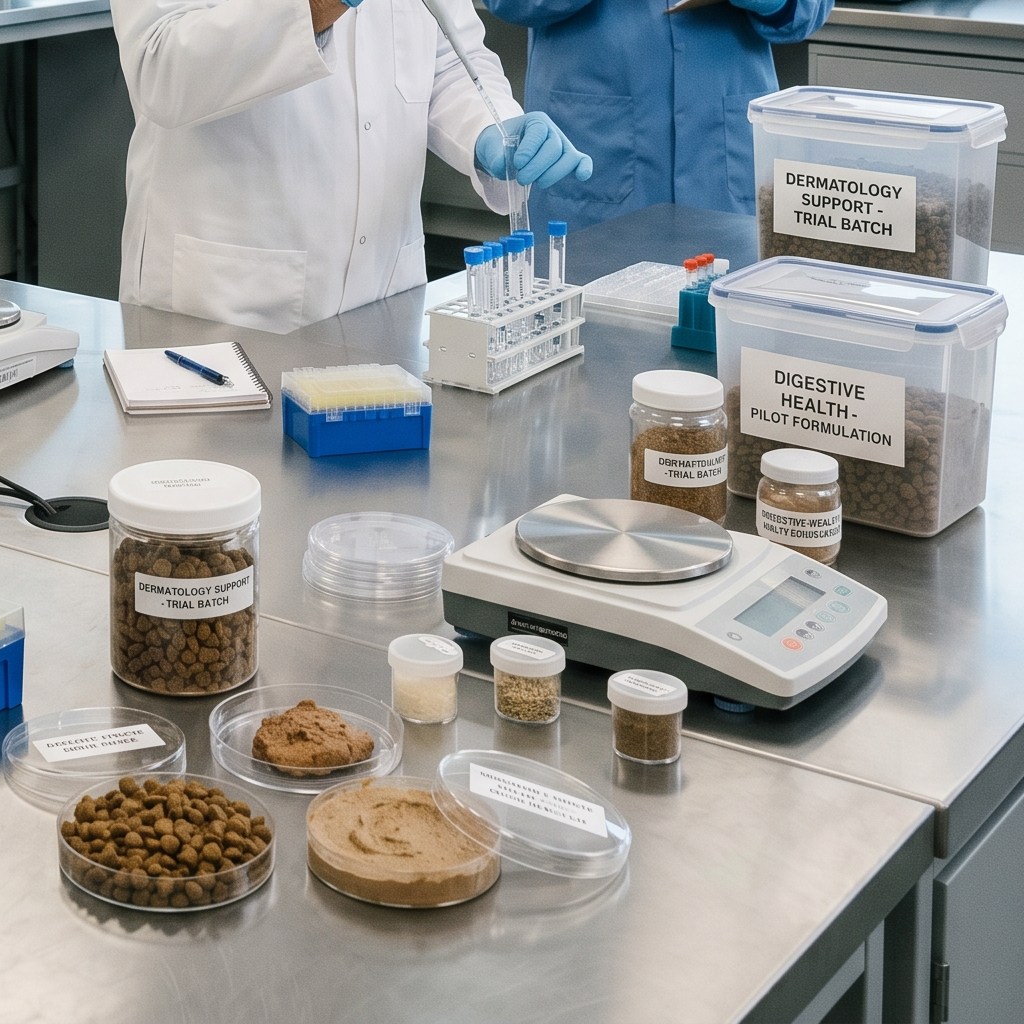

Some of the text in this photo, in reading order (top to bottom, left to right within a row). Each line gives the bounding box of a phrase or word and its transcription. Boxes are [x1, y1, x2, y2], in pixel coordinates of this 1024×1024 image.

[786, 172, 902, 199] DERMATOLOGY
[801, 193, 873, 215] SUPPORT
[794, 210, 893, 236] TRIAL BATCH
[774, 369, 866, 401] DIGESTIVE
[750, 407, 892, 447] PILOT FORMULATION
[139, 576, 250, 597] DERMATOLOGY SUPPORT
[197, 596, 229, 609] BATCH
